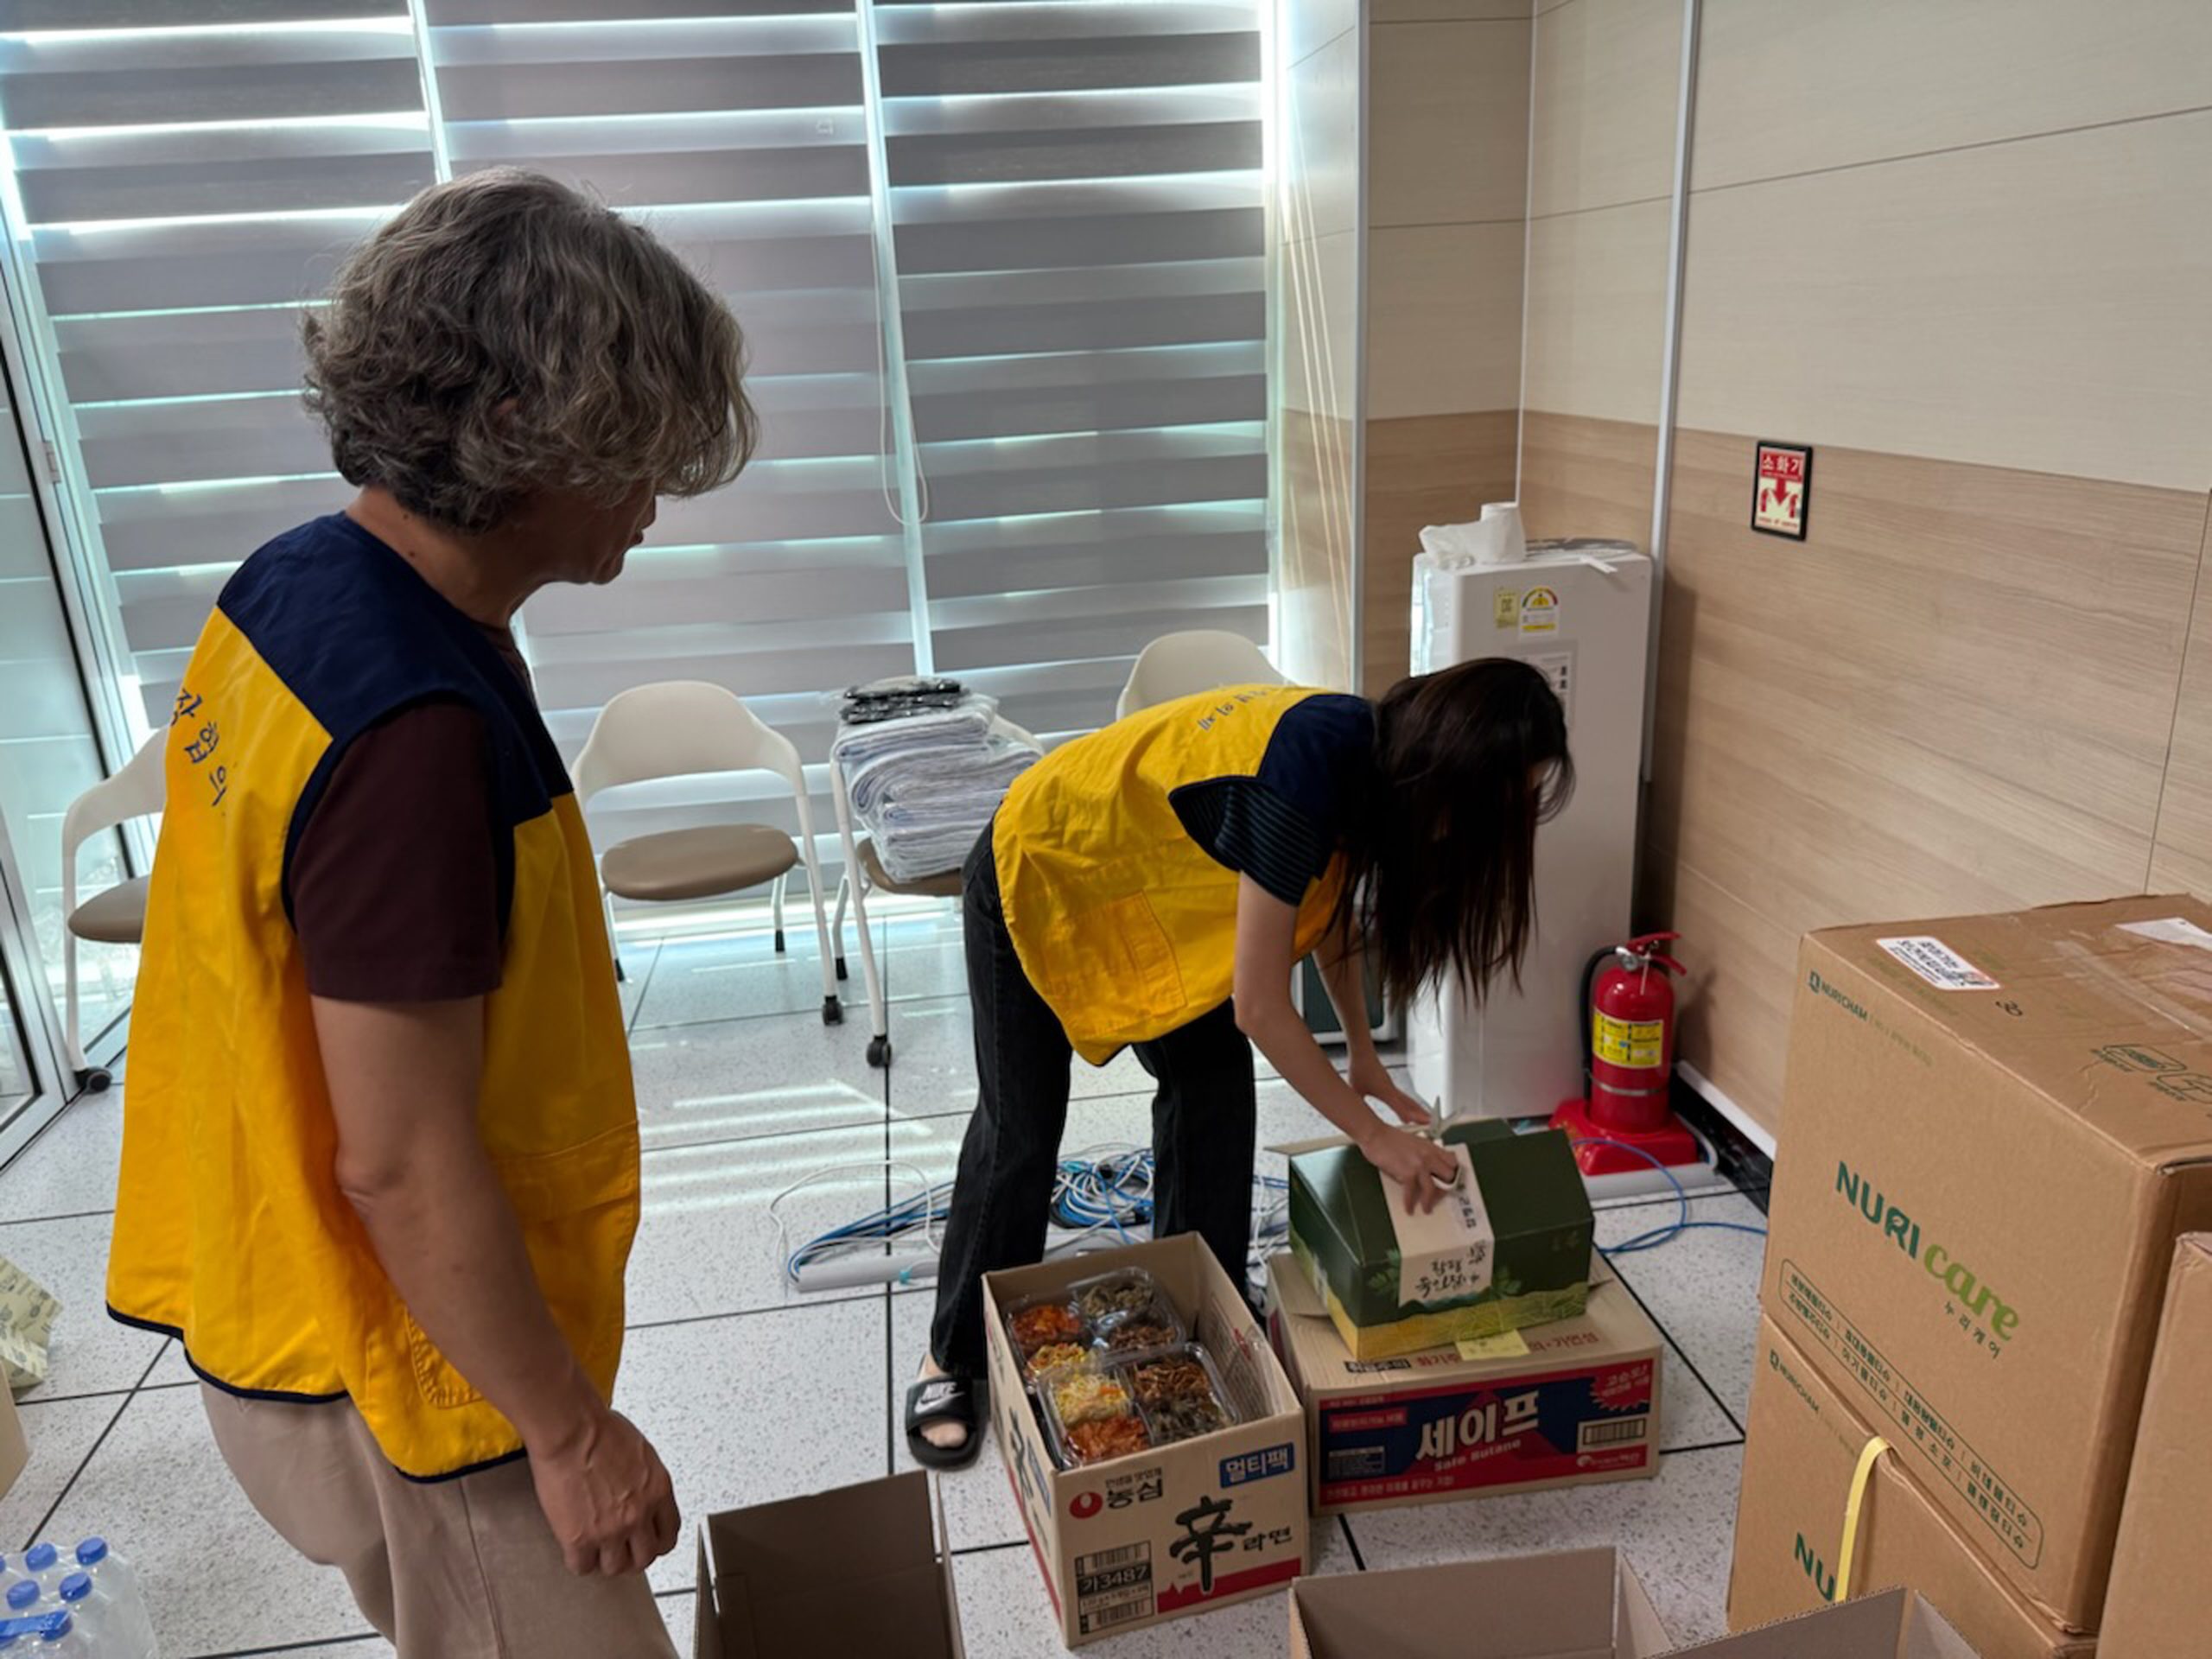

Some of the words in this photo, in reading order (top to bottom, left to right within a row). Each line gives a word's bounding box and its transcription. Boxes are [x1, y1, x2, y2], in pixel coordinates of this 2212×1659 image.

[1763, 454, 1803, 476] 소화기
[1835, 1160, 1921, 1259] NURI
[1923, 1243, 2019, 1341] care
[1945, 1300, 2001, 1359] 누리케어
[1415, 1390, 1540, 1461] 세이프
[1225, 1447, 1289, 1484] 멀티팩
[1434, 1455, 1467, 1471] Safe
[1471, 1440, 1522, 1460] Butane
[1107, 1478, 1163, 1510] 농심
[1169, 1496, 1253, 1592] 辛
[1243, 1526, 1293, 1551] 라면
[1082, 1565, 1147, 1592] 가3487
